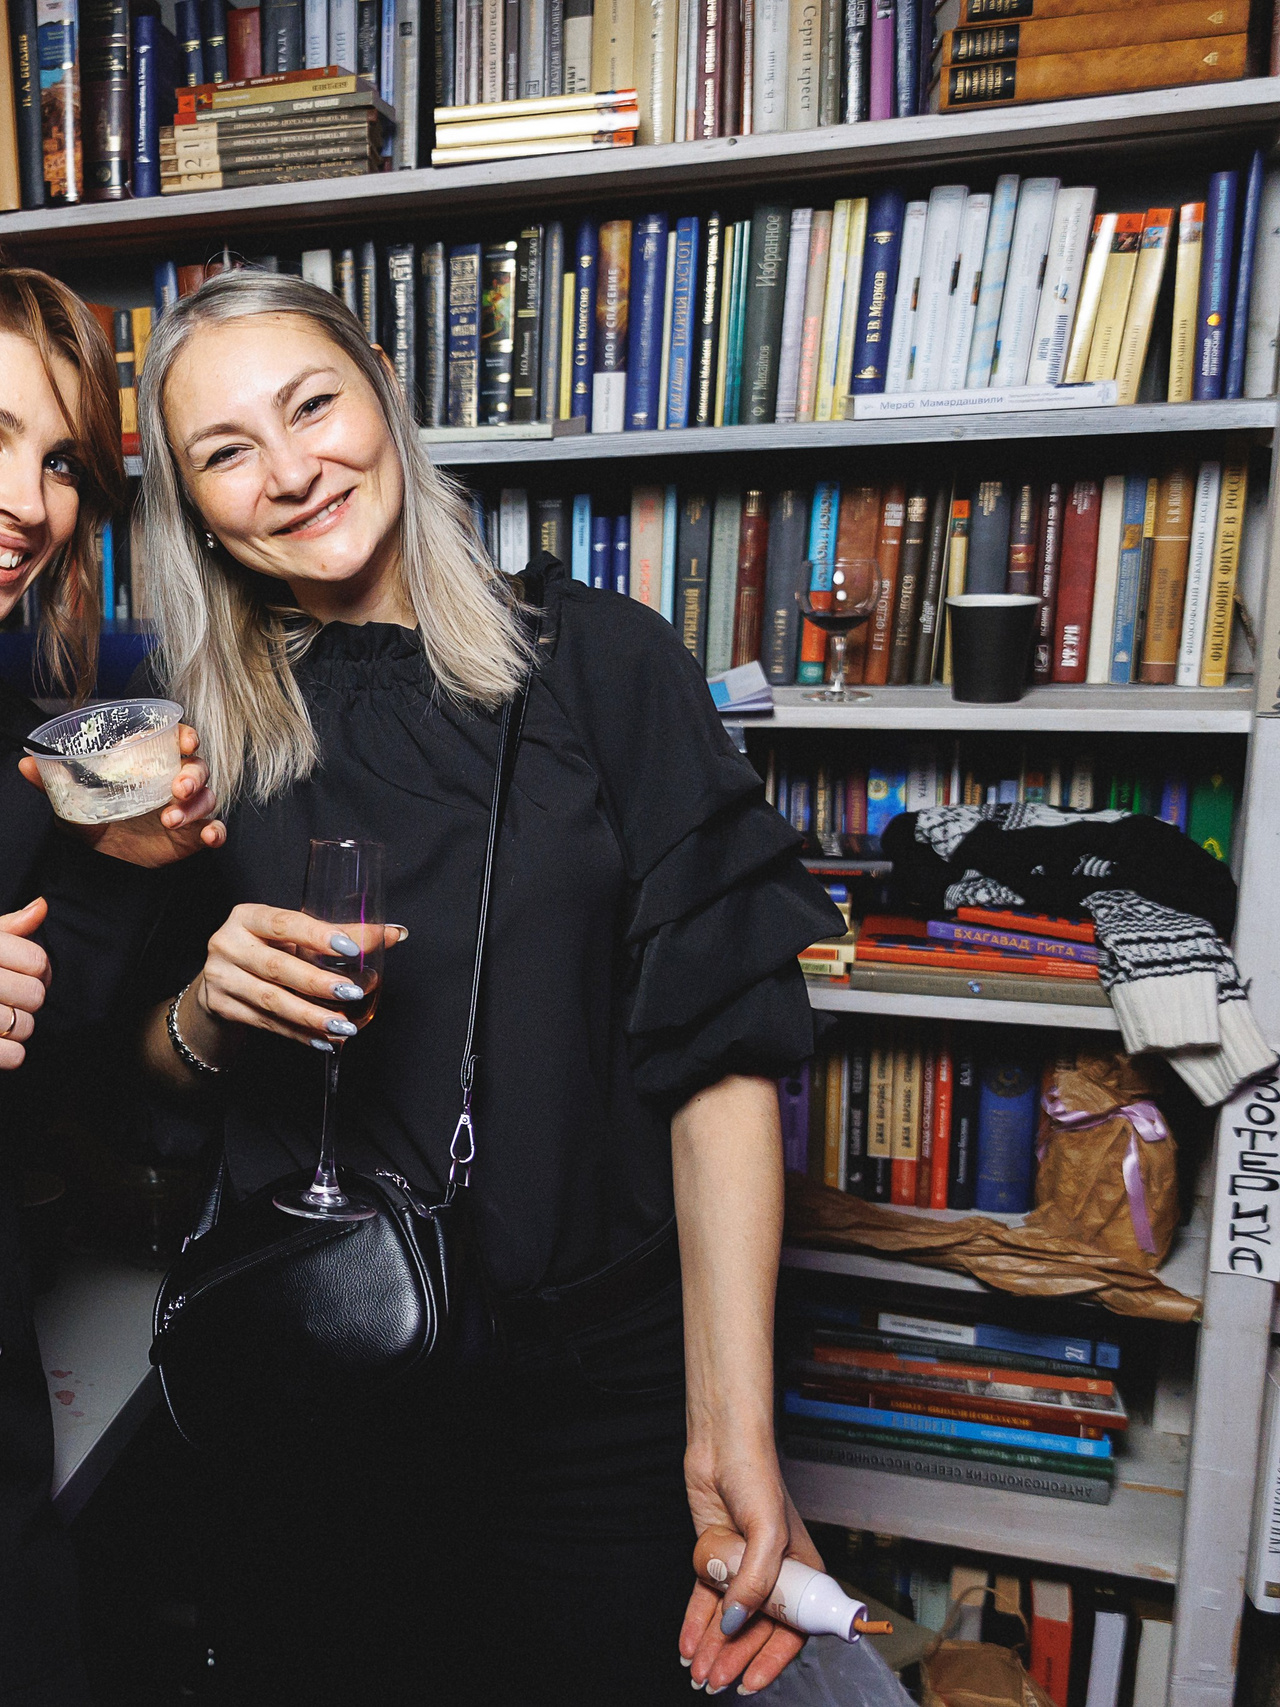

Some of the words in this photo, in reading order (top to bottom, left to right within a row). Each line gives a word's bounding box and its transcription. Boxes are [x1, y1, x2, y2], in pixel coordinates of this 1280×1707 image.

[799, 6, 816, 46] Серп
[19, 34, 29, 78] БЕРДЯЕВ
[551, 51, 560, 87] РАЗУМЕ
[705, 28, 716, 73] ПРОБЛЕМА
[803, 53, 812, 61] и
[798, 67, 811, 112] крест
[184, 158, 201, 169] 2
[1218, 180, 1229, 209] МЫСЛИ
[755, 215, 782, 287] Избранное
[1214, 211, 1225, 260] ФИЛОСОФИЯ
[520, 265, 528, 281] БОГ
[528, 258, 537, 300] МИРОВОЕ
[675, 240, 691, 292] ГУСТОТ
[1210, 262, 1221, 311] БУДДИЙСКАЯ
[395, 283, 405, 317] contra
[527, 300, 535, 308] И
[577, 287, 589, 339] Колесова
[606, 268, 617, 328] СПАСЕНИЕ
[869, 271, 886, 317] Марков
[605, 332, 614, 340] И
[672, 296, 688, 349] ТЕОРИЯ
[866, 333, 879, 343] Б.
[867, 320, 880, 330] В.
[604, 344, 614, 366] ЗЛО
[700, 339, 712, 378] Маймон
[753, 345, 771, 390] Михайлов
[1036, 337, 1050, 361] МЕРАБ
[1049, 315, 1068, 385] МАМАРДАШВИЛИ
[1202, 338, 1211, 376] АЛЕКСАНДР
[1210, 330, 1221, 376] ПЯТИГОРСКИЙ
[696, 380, 708, 422] Соломон
[751, 394, 765, 403] Т.
[751, 404, 765, 416] Ф.
[880, 400, 916, 411] Мераб
[920, 395, 1004, 409] Мамардашвили
[1217, 530, 1235, 575] ФИХТЕ
[875, 578, 891, 630] ФЕДОТОВ
[1185, 587, 1199, 656] ФИЛОСОФСКИЙ
[1192, 532, 1206, 585] ДЕКАМЕРОН
[1210, 580, 1230, 662] ФИЛОСОФИЯ
[965, 1468, 1092, 1499] АНТРОПОЭКОЛОГИЯ
